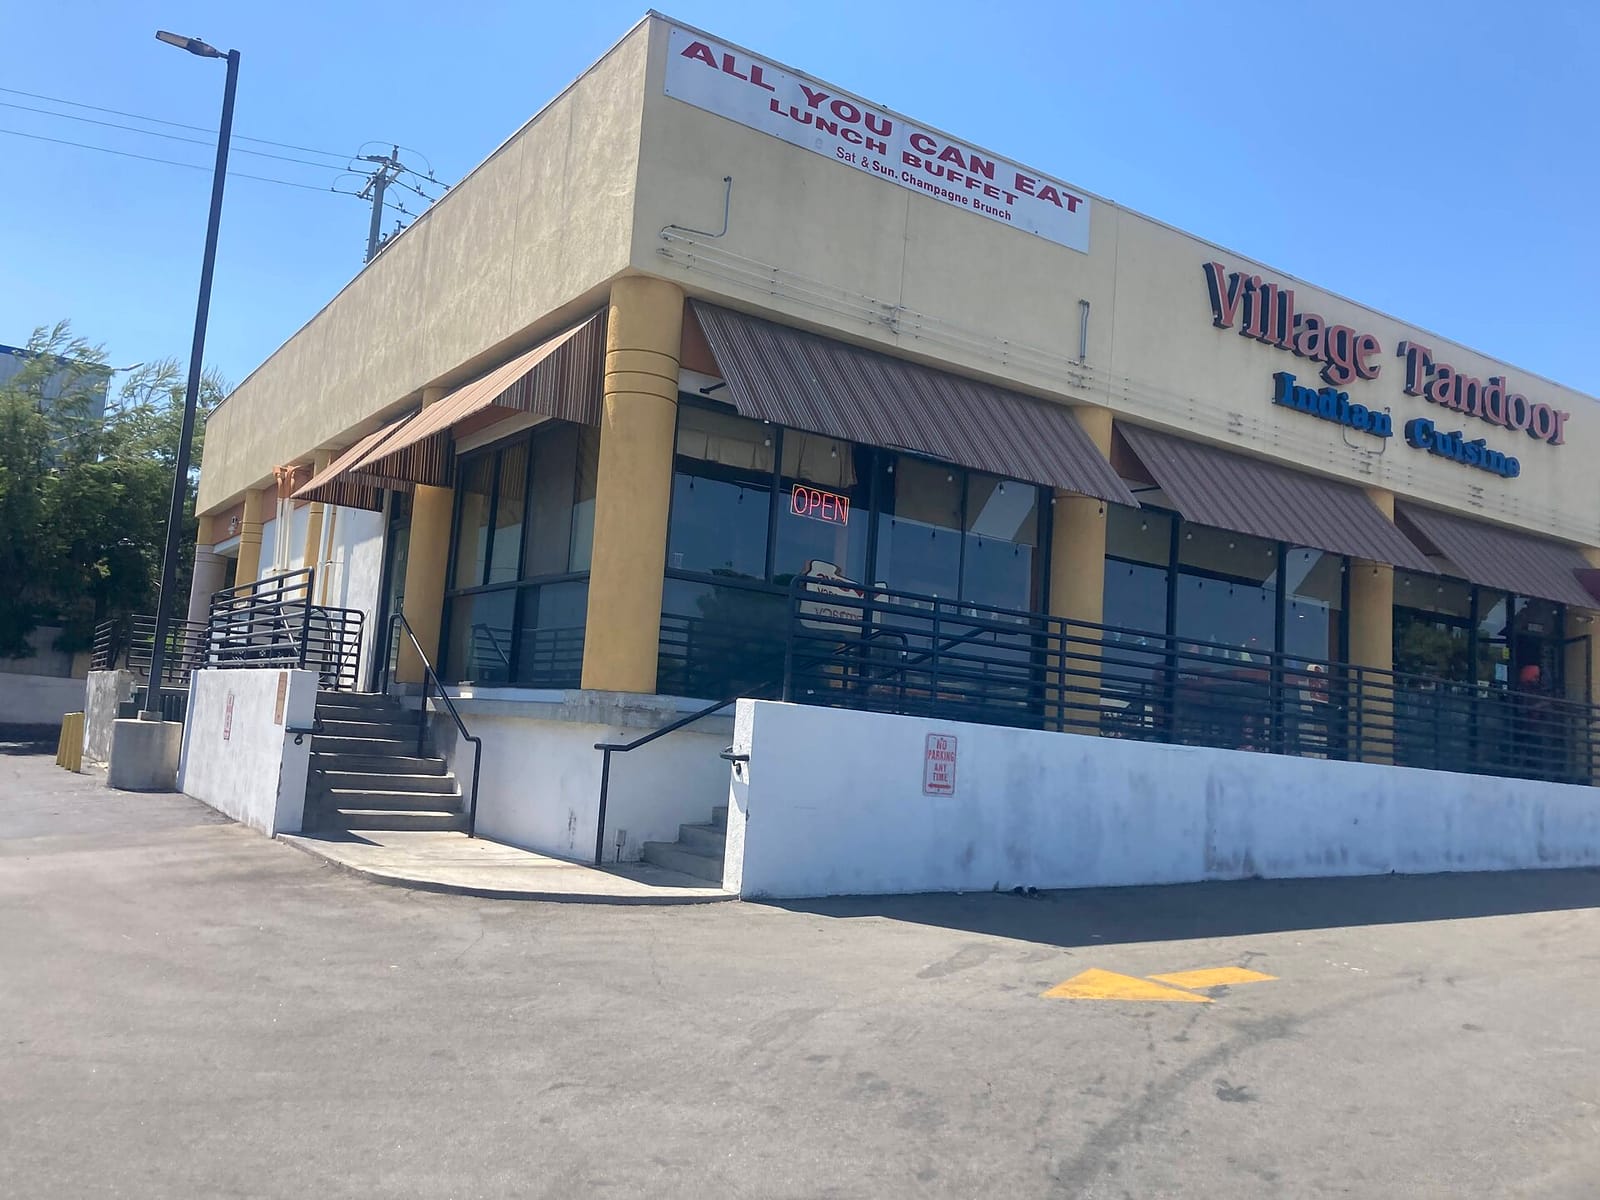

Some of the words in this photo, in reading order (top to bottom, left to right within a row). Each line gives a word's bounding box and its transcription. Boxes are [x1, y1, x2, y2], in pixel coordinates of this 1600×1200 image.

[681, 41, 775, 92] ALL
[799, 83, 892, 137] YOU
[909, 133, 995, 180] CAN
[1014, 172, 1083, 213] EAT
[769, 98, 887, 155] LUNCH
[902, 151, 1019, 205] BUFFET
[836, 146, 856, 164] Sat
[861, 156, 869, 169] &
[872, 160, 898, 179] Sun.
[901, 171, 968, 205] Champagne
[973, 198, 1012, 221] Brunch
[1202, 261, 1382, 386] Village
[1396, 340, 1570, 446] Tandoor
[1271, 371, 1394, 438] Indian
[1404, 417, 1521, 478] Cuisine
[793, 487, 848, 523] OPEN
[927, 749, 955, 762] PARKING
[934, 763, 946, 773] ANY
[936, 740, 947, 750] NO
[932, 772, 948, 782] TIME
